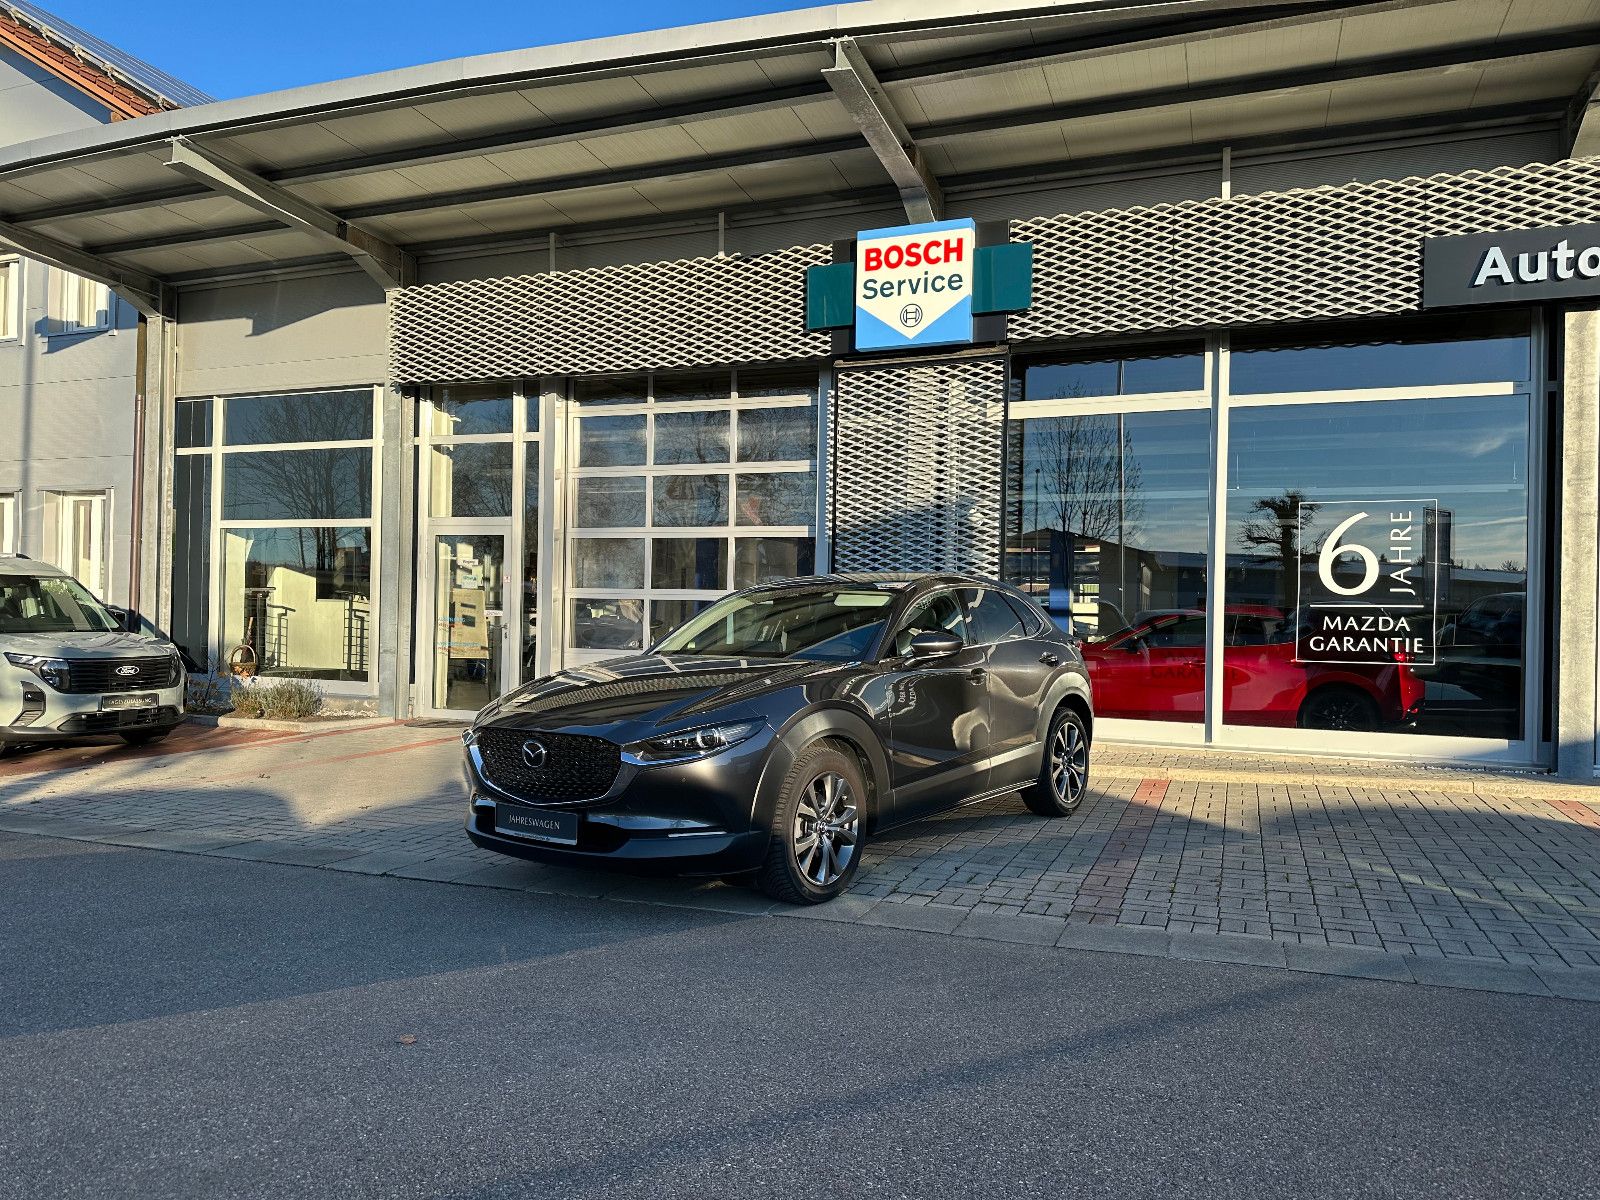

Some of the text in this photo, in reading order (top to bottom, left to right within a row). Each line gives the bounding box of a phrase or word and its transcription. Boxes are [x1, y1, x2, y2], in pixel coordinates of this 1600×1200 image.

[864, 238, 963, 271] BOSCH
[1474, 239, 1600, 286] Auto
[862, 270, 963, 300] Service
[1318, 510, 1416, 596] 6 JAHRE
[1322, 616, 1411, 632] MAZDA
[1309, 636, 1424, 653] GARANTIE
[508, 814, 560, 830] JAHRESWAGEN
